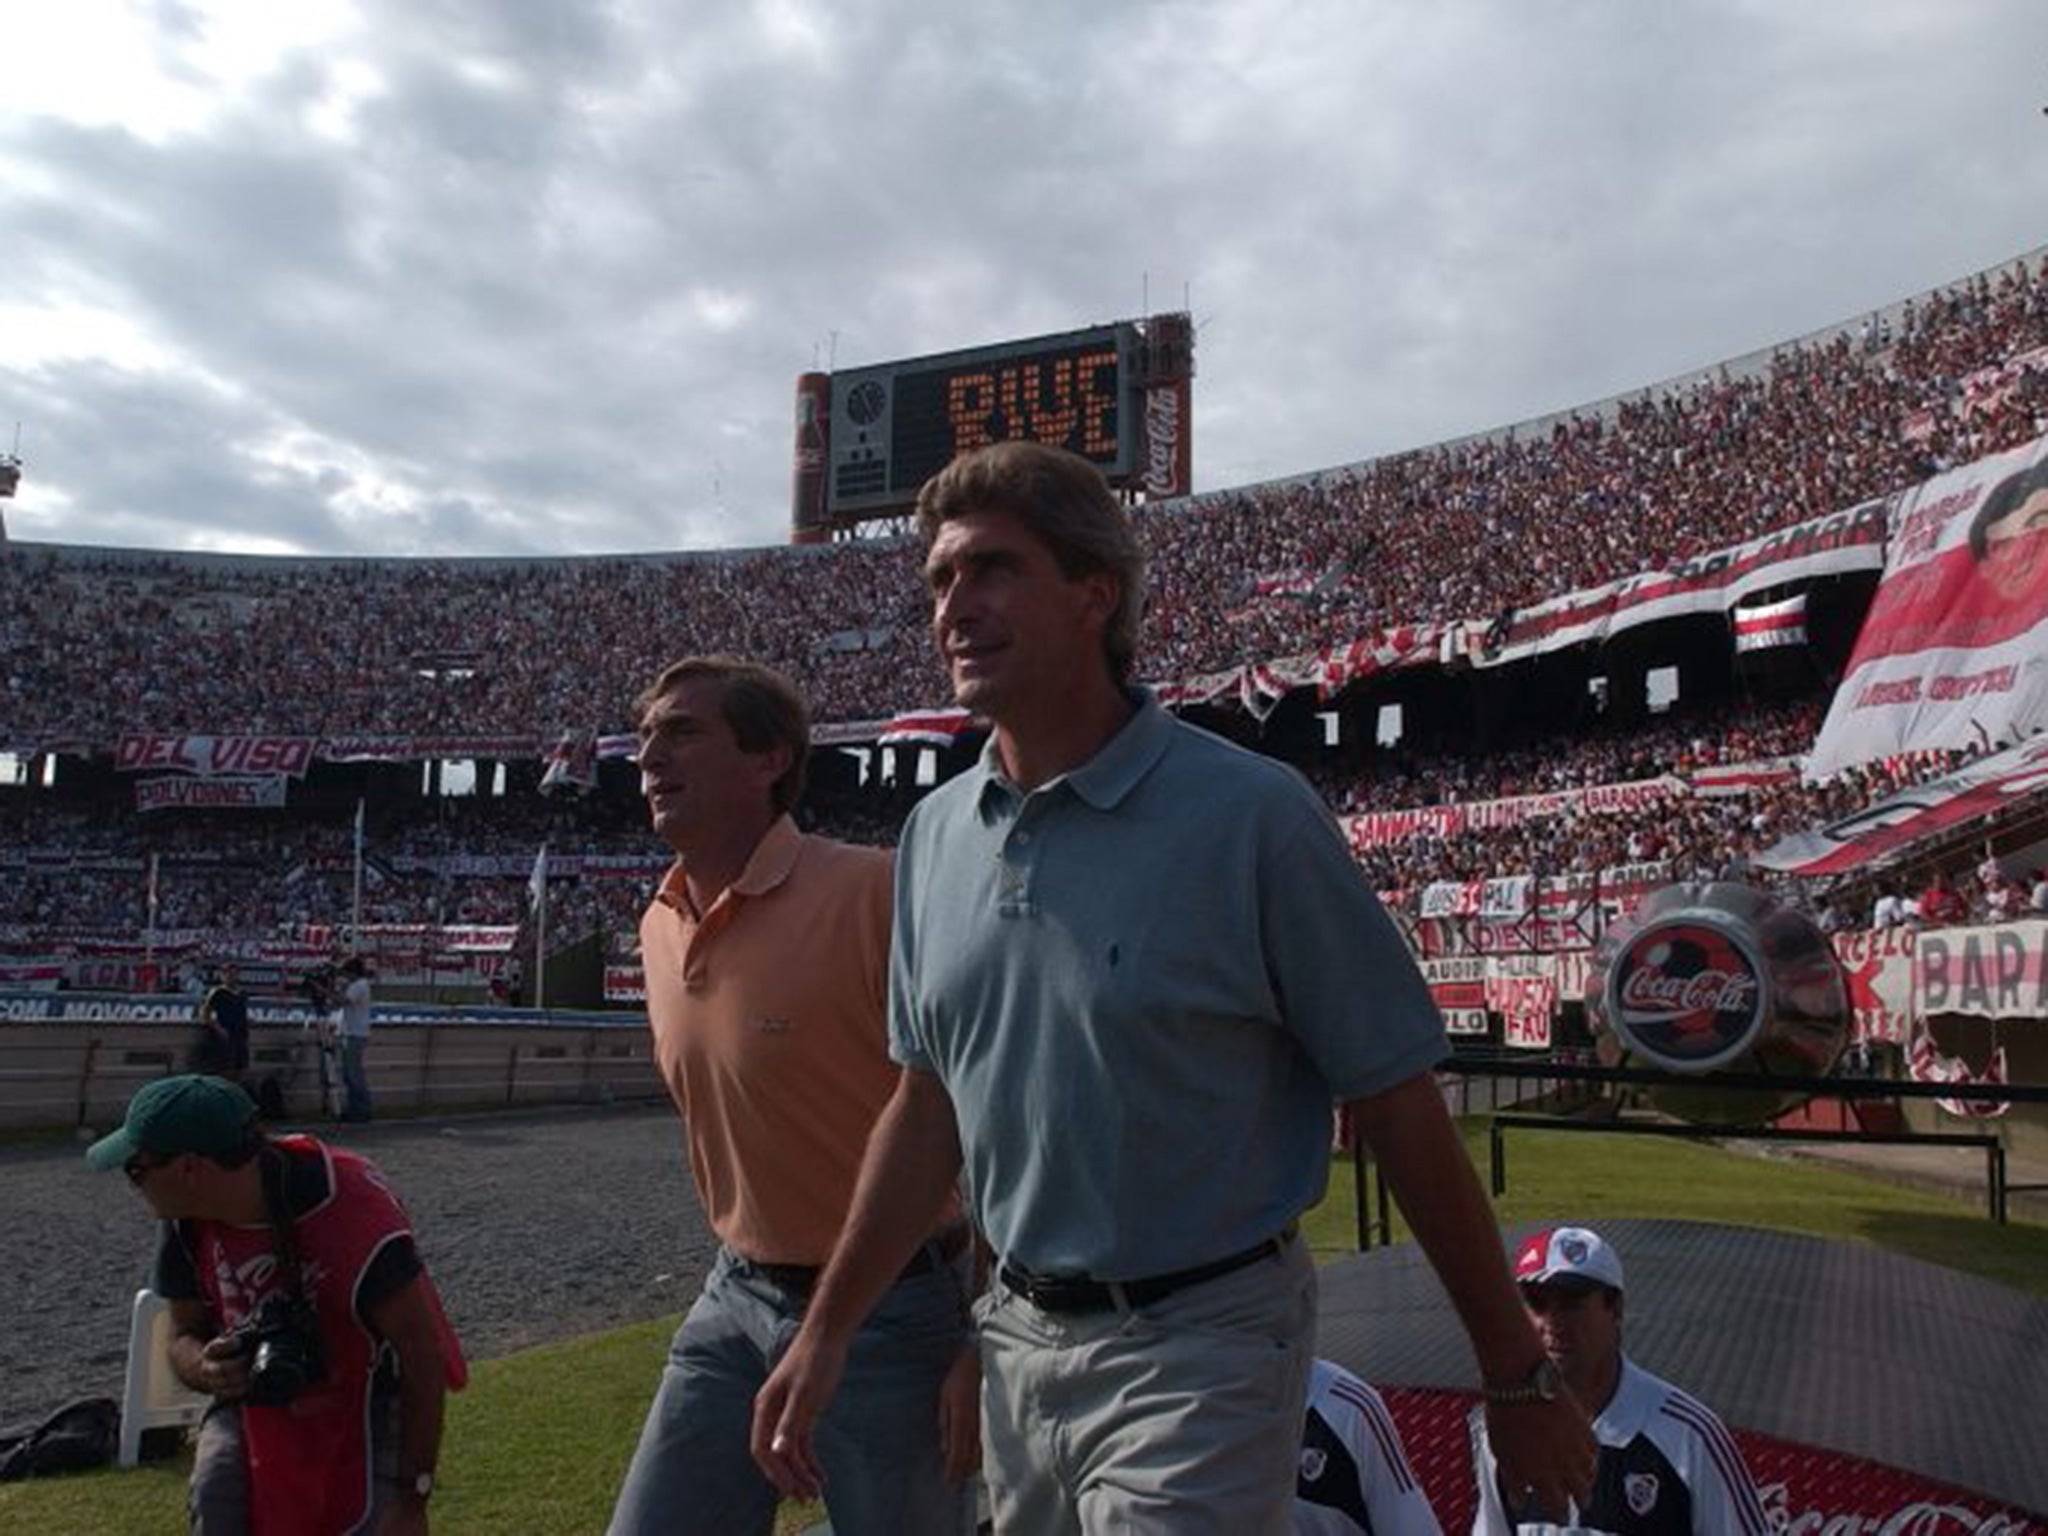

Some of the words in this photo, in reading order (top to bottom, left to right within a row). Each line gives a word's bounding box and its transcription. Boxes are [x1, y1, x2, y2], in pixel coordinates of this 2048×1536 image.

[119, 736, 198, 767] DEL
[210, 737, 312, 772] VISO
[1622, 965, 1757, 1012] Coca-Cola
